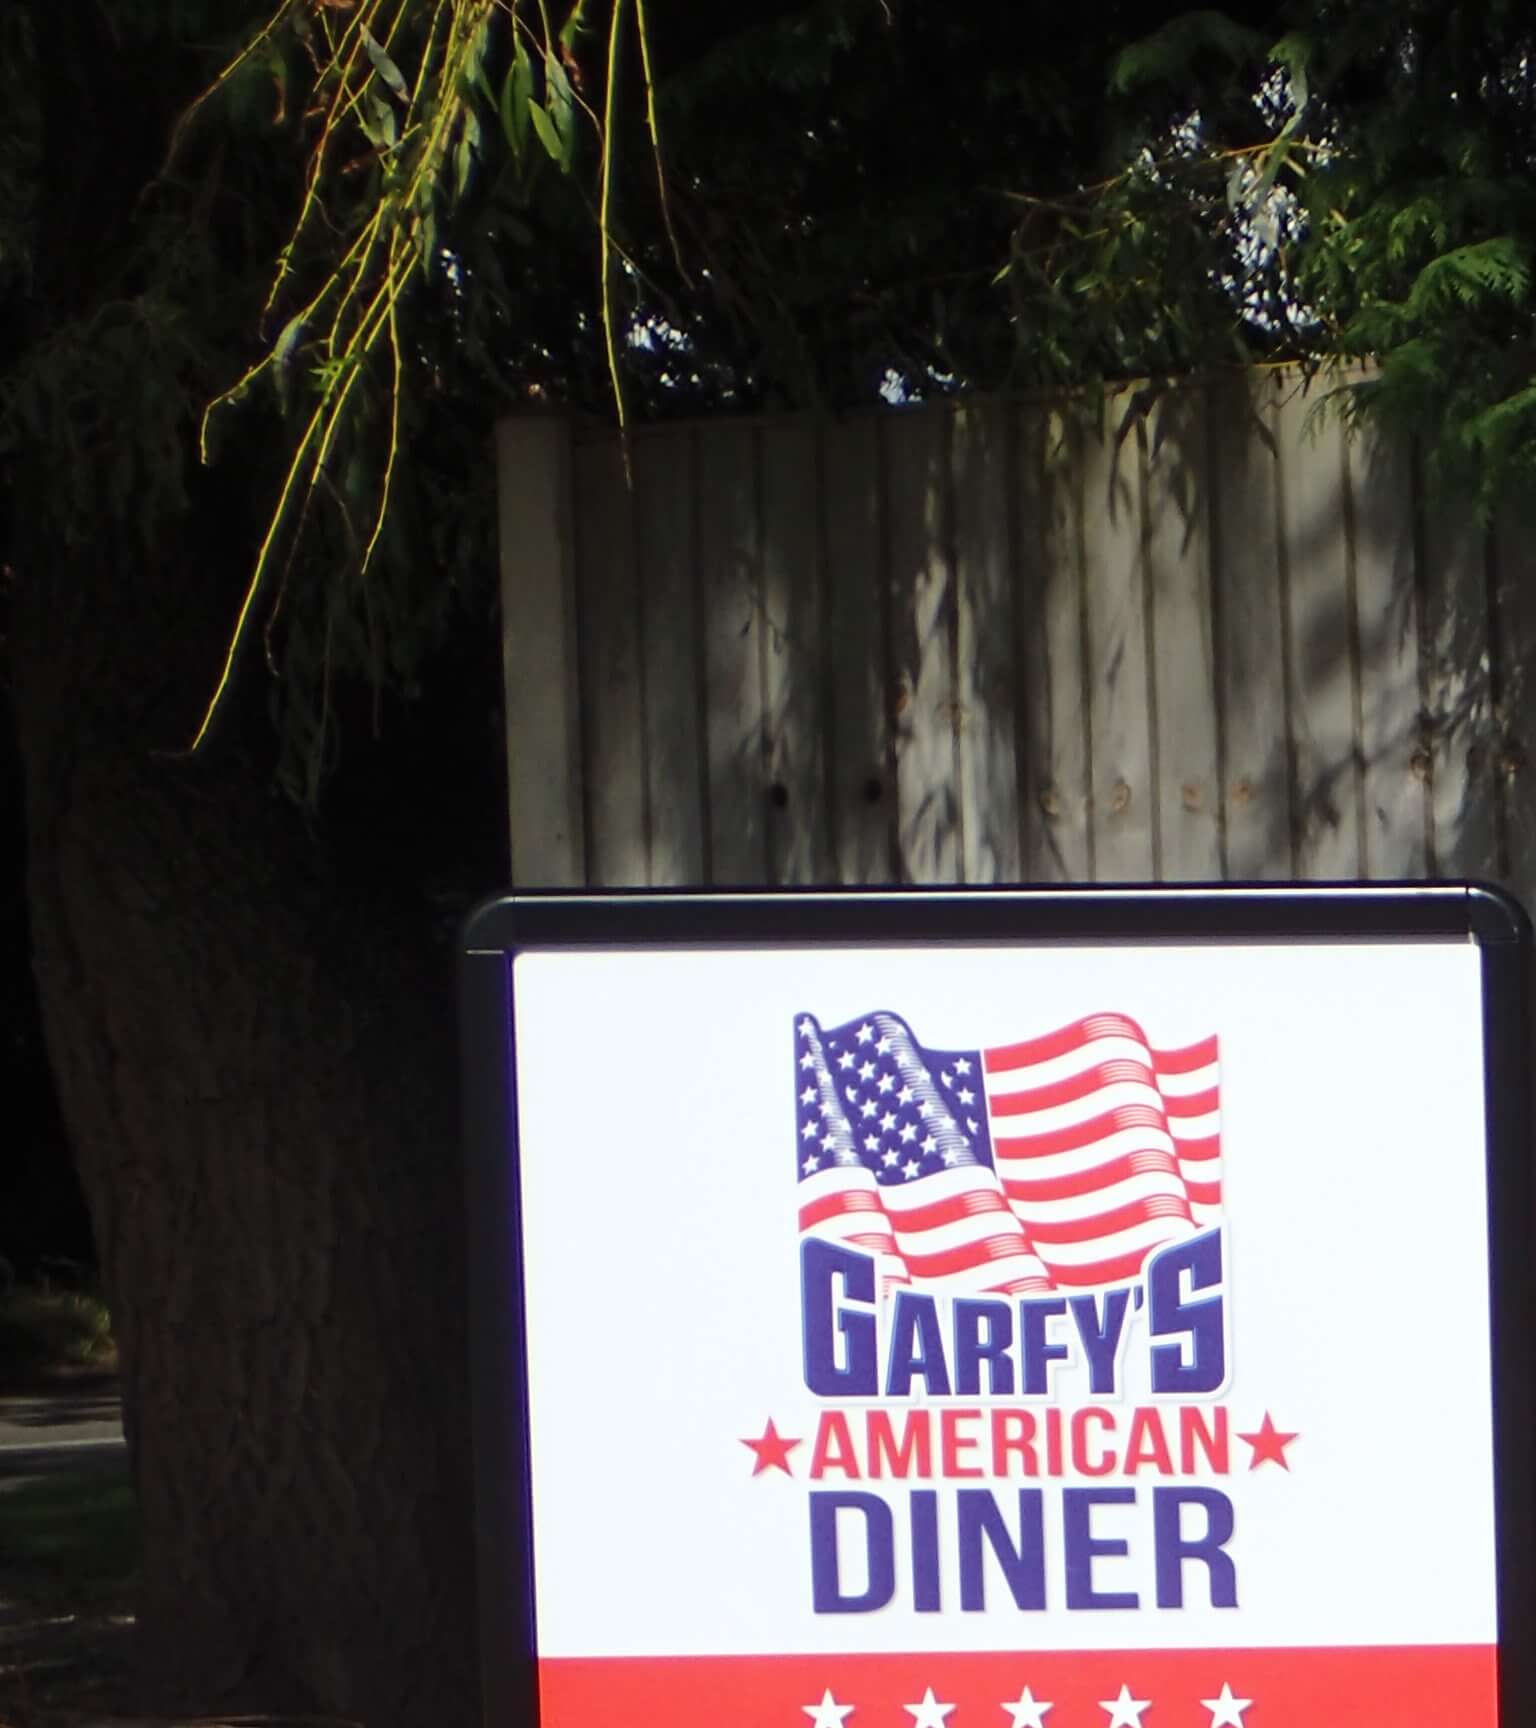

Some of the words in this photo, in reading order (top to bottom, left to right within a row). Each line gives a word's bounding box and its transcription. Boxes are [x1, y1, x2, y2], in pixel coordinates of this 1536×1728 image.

[801, 1226, 1226, 1397] GARFY'S
[809, 1406, 1230, 1480] AMERICAN
[809, 1486, 1239, 1615] DINER
